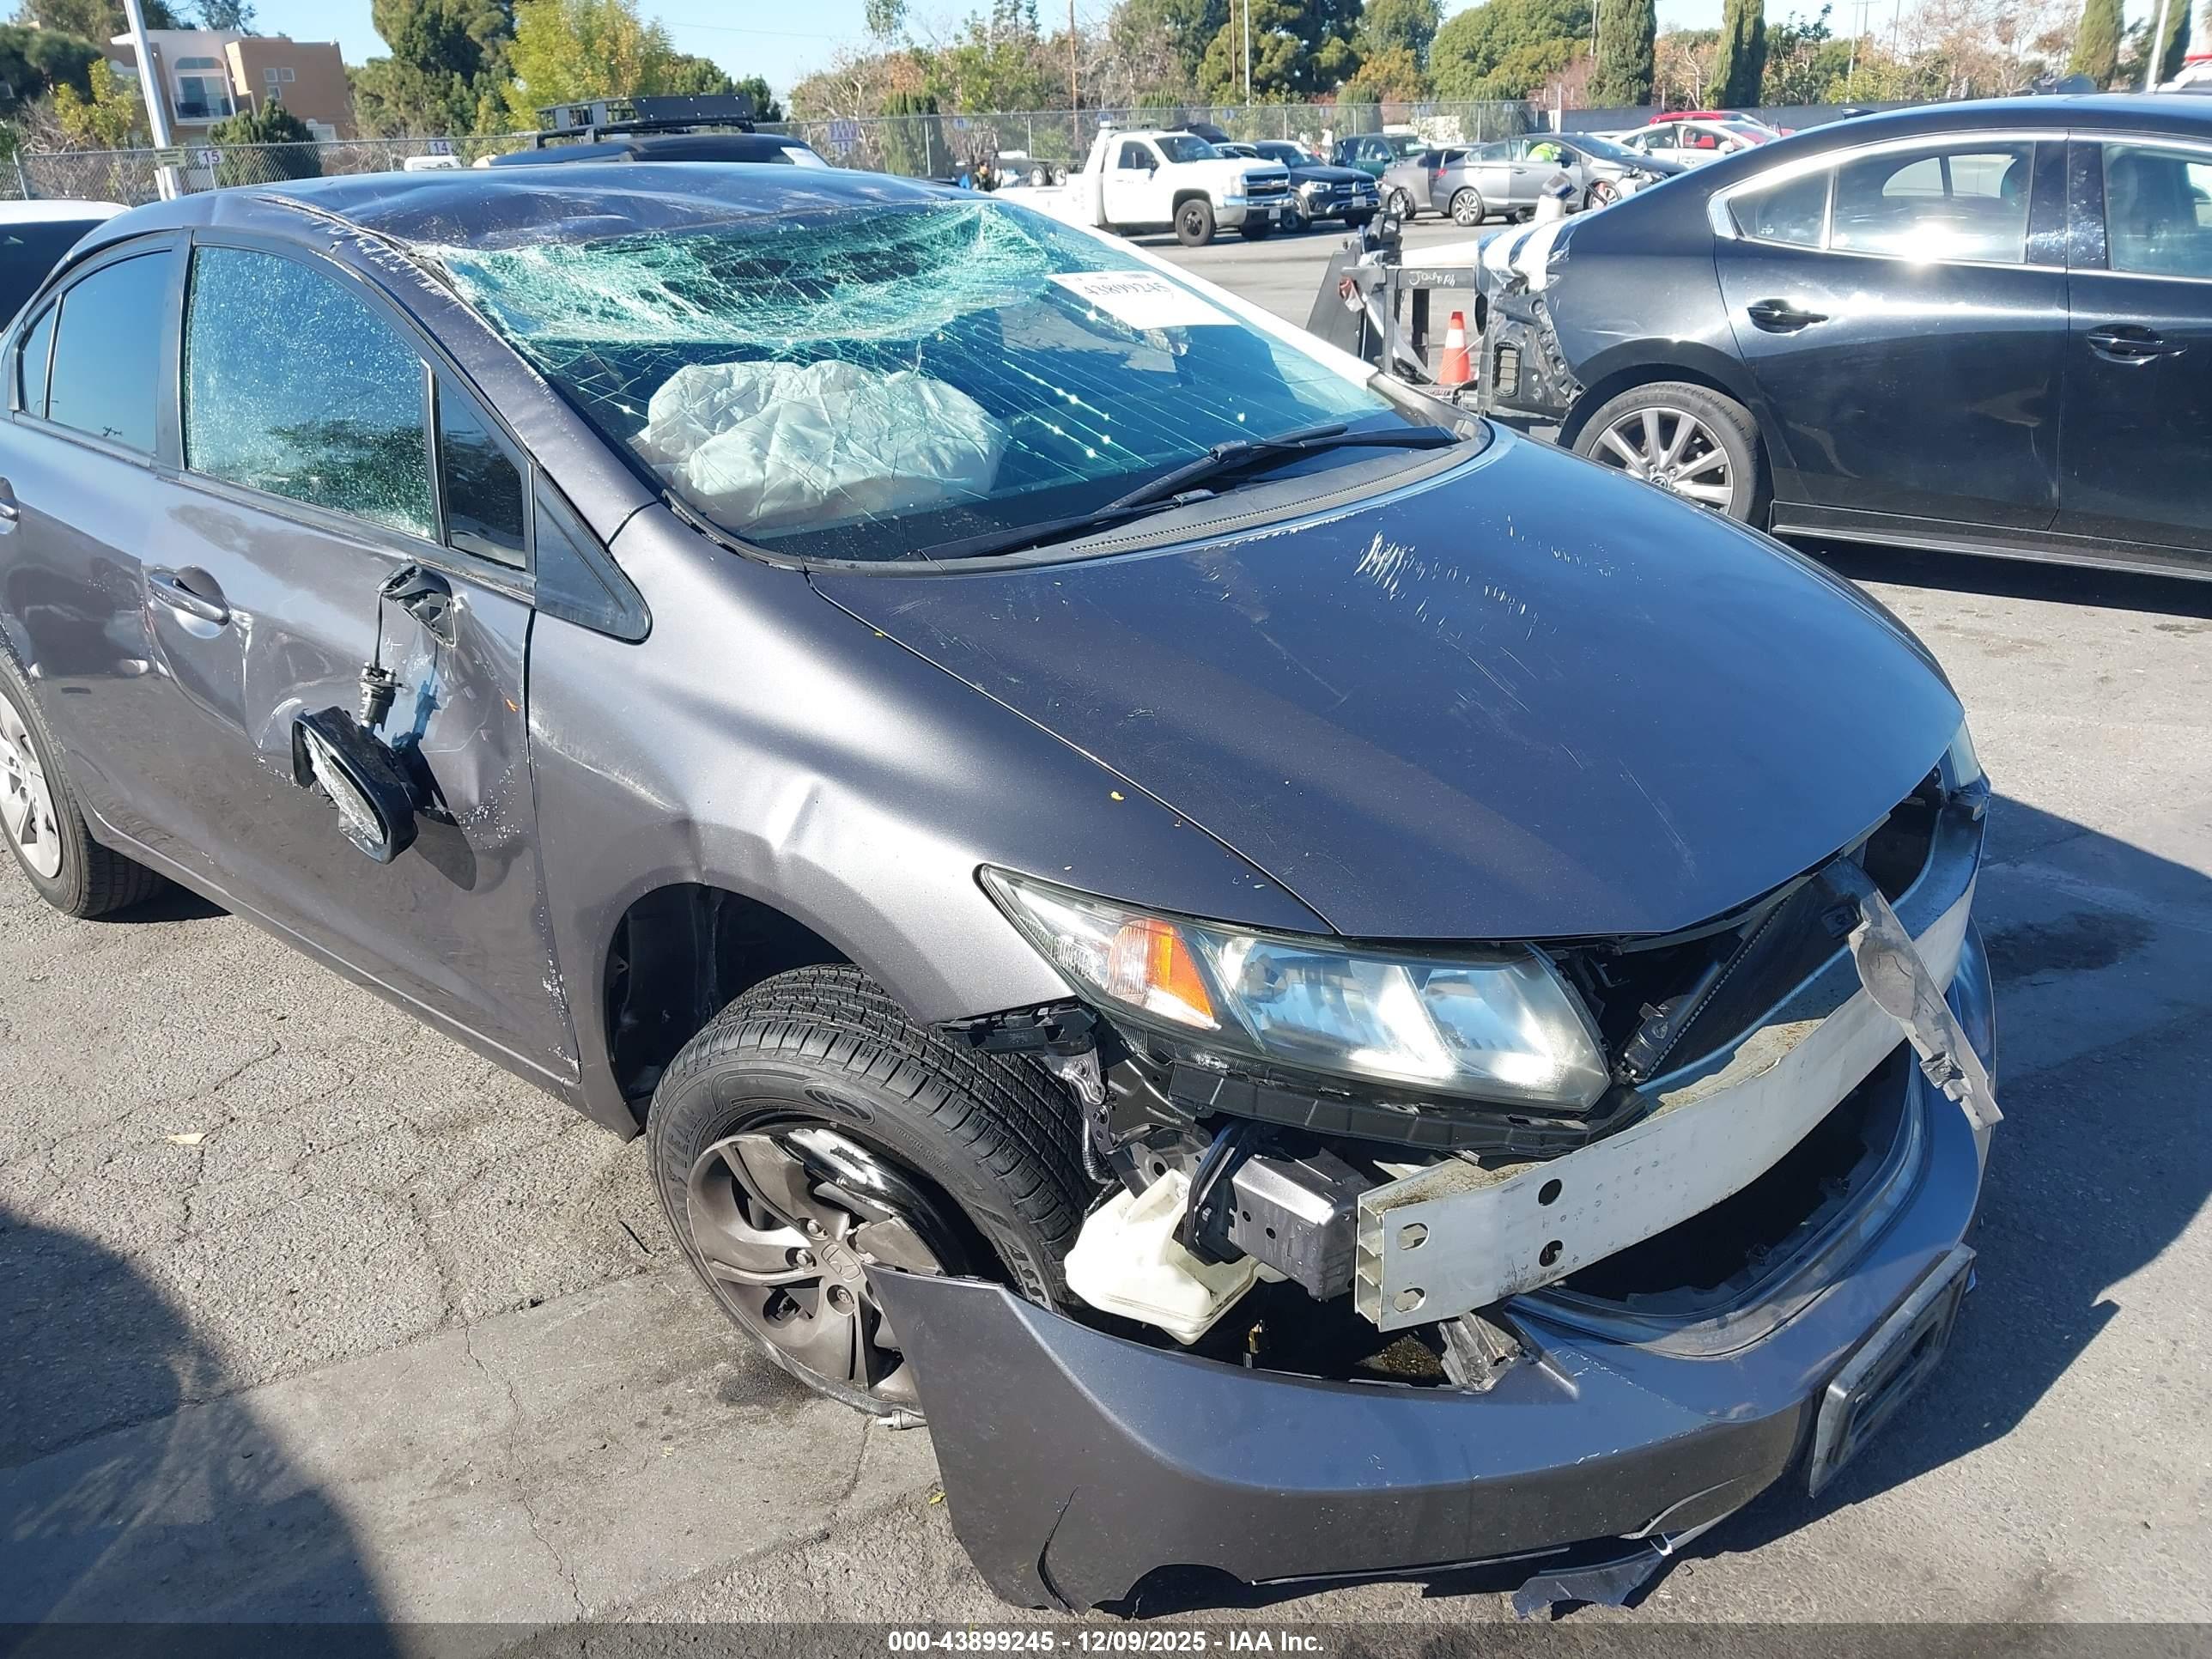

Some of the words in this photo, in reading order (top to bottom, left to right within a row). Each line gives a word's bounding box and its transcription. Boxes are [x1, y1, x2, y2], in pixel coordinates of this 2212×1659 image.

[433, 142, 448, 152] 14
[838, 142, 849, 152] 12
[202, 150, 220, 163] 15
